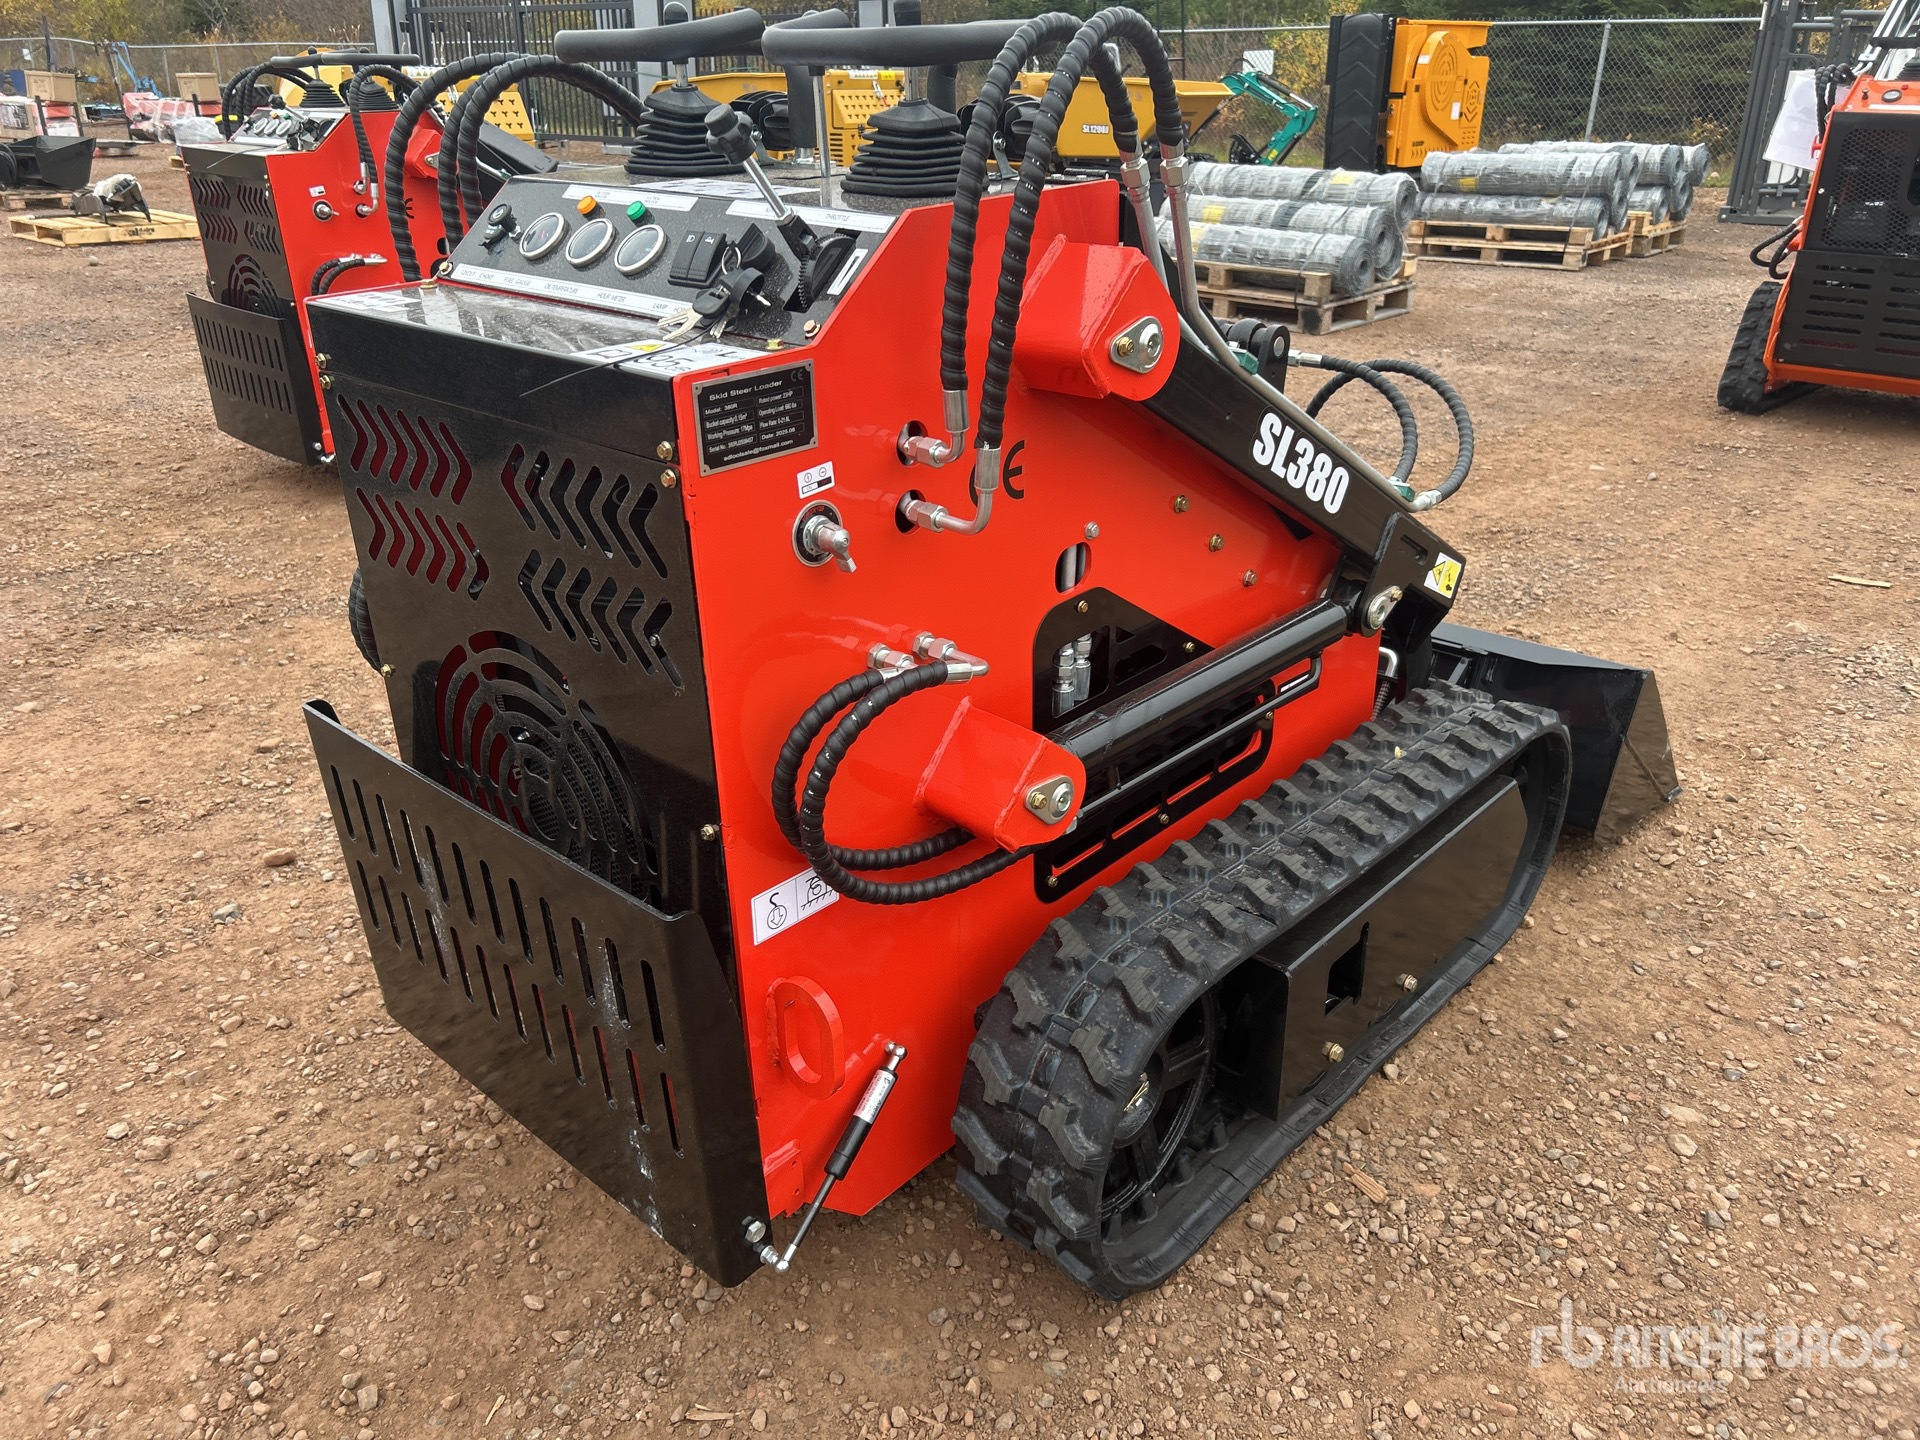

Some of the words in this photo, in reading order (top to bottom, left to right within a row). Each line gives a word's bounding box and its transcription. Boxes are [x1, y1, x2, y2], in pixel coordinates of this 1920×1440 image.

[825, 213, 850, 222] THROTTLE
[515, 278, 532, 286] GAUGE
[611, 295, 626, 303] METER
[652, 303, 668, 311] LAMP
[791, 369, 804, 382] CE
[709, 391, 728, 401] Skid
[730, 387, 752, 397] Steer
[754, 380, 783, 391] Loader
[705, 406, 722, 415] Model:
[759, 407, 776, 417] Operating
[706, 419, 720, 429] Bucket
[707, 431, 723, 440] Working
[761, 432, 775, 441] Date:
[709, 445, 720, 454] Serial
[1252, 412, 1350, 514] SL380
